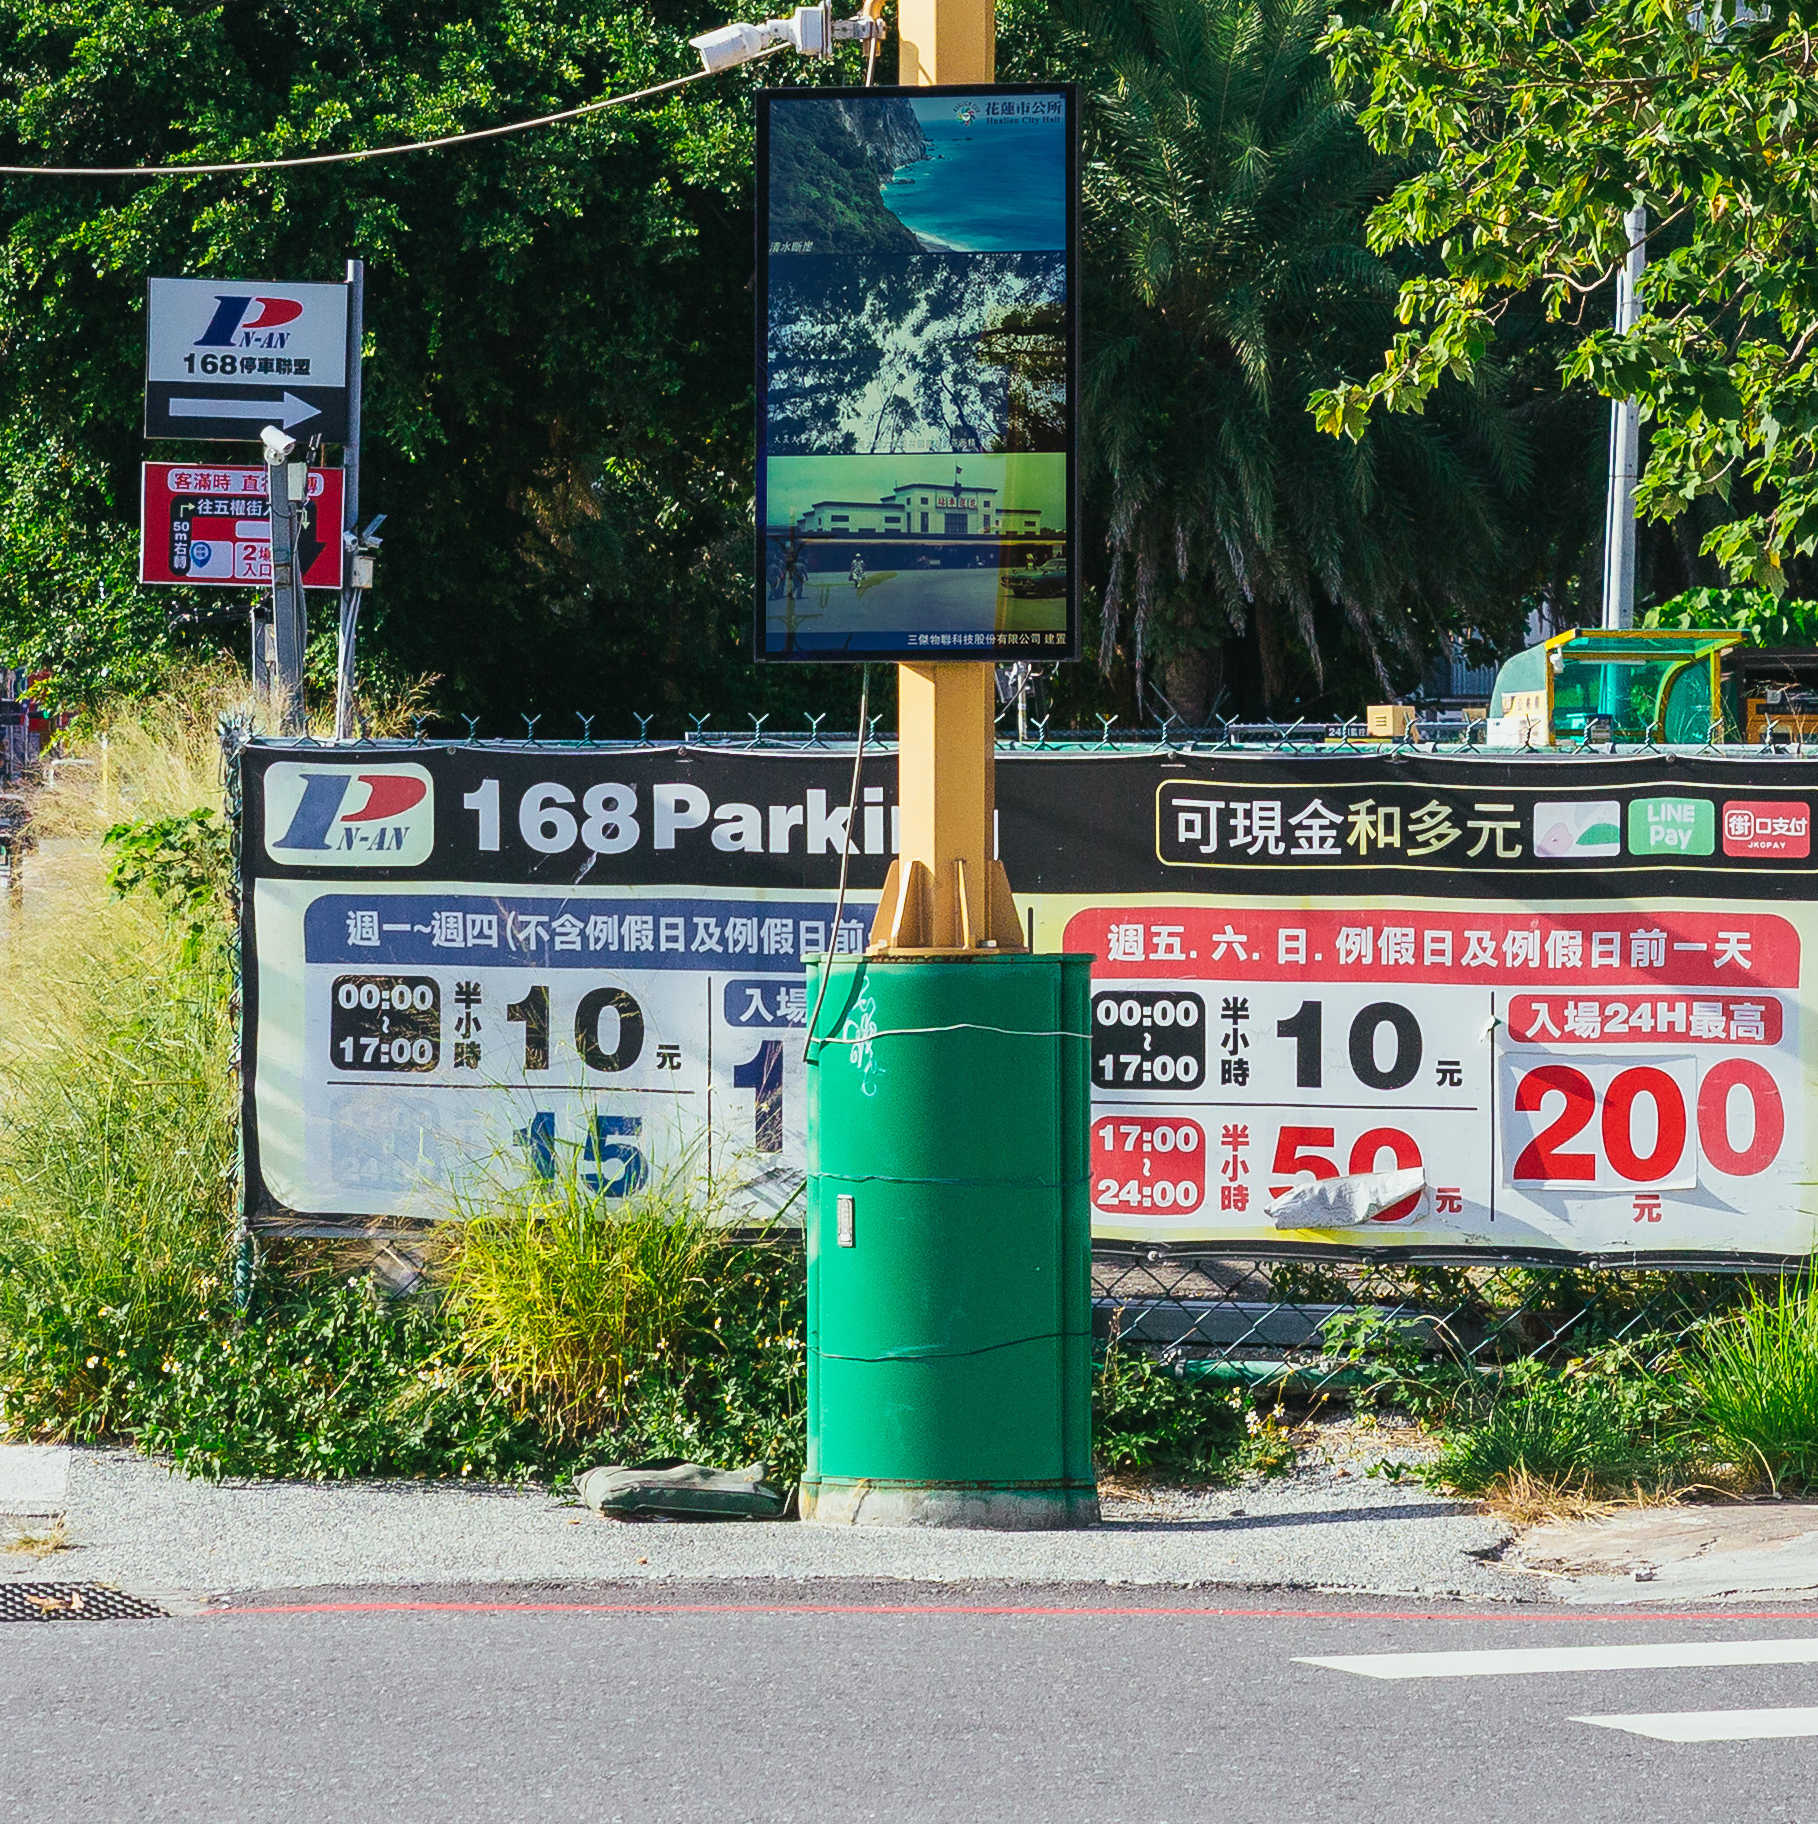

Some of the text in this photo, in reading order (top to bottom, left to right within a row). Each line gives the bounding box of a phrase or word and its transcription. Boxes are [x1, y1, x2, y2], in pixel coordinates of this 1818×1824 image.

[986, 101, 1062, 116] 花蓮市公所
[986, 116, 1061, 126] Hualien City Hall
[908, 633, 1066, 646] 三傑物聯科技股份有限公司 建置
[655, 782, 999, 860] Parki
[1171, 797, 1524, 859] 可現金和多元
[1647, 803, 1696, 824] LINE
[1726, 811, 1808, 839] 街口支付
[1649, 825, 1693, 850] Pay
[337, 984, 434, 1011] 00:00
[453, 980, 482, 1070] 半小時
[1096, 999, 1200, 1028] 00:00
[506, 985, 645, 1073] 10
[1220, 996, 1250, 1087] 半小時
[339, 1037, 434, 1065] 17:00
[656, 1043, 682, 1070] 元
[1276, 1000, 1424, 1091] 10
[1097, 1053, 1200, 1083] 17:00
[1435, 1059, 1464, 1088] 元
[1513, 1057, 1785, 1183] 200
[1097, 1124, 1200, 1154] 17:00
[512, 1111, 650, 1198] 15
[1220, 1123, 1250, 1212] 半小時
[1096, 1179, 1200, 1208] 24:00
[1435, 1186, 1464, 1214] 元
[1631, 1193, 1663, 1224] 元
